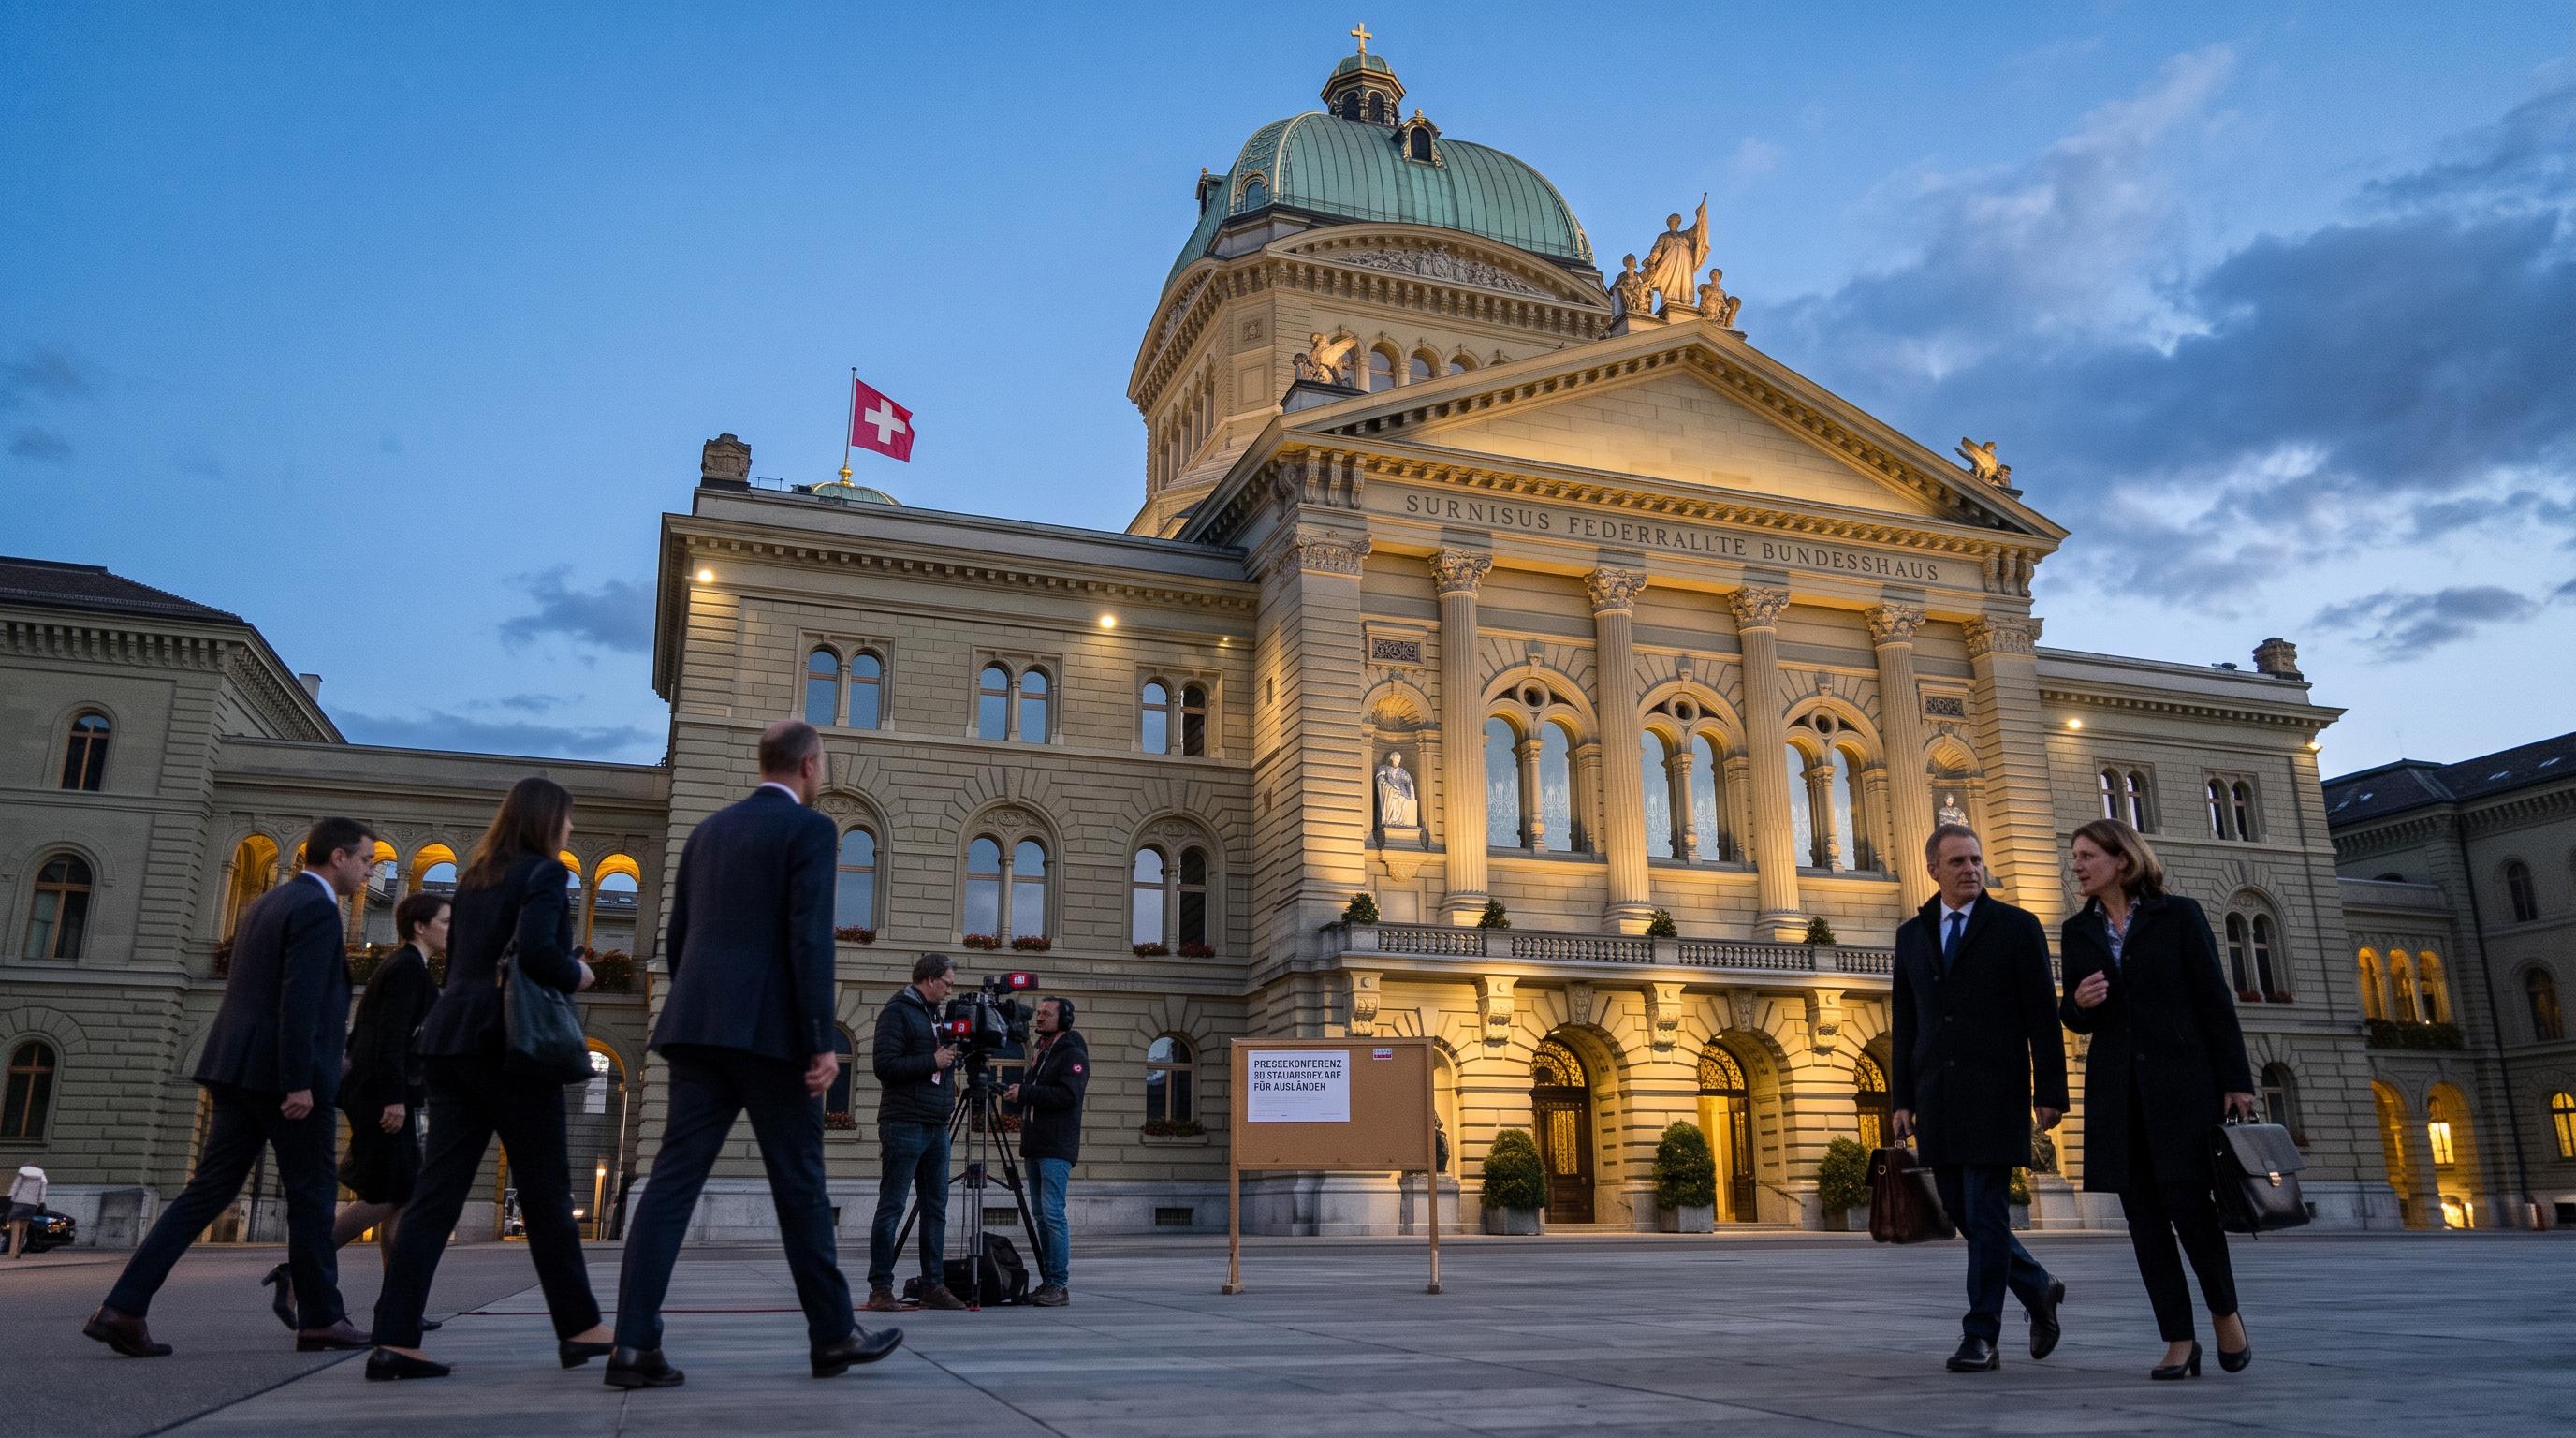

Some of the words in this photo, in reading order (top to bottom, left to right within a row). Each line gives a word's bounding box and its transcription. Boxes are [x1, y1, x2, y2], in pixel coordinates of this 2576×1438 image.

[1406, 494, 1550, 530] SURNISUS
[1763, 543, 1939, 580] BUNDESSHAUS
[1254, 1059, 1342, 1068] PRESSEKONFERENZ
[1254, 1080, 1271, 1091] FÜR
